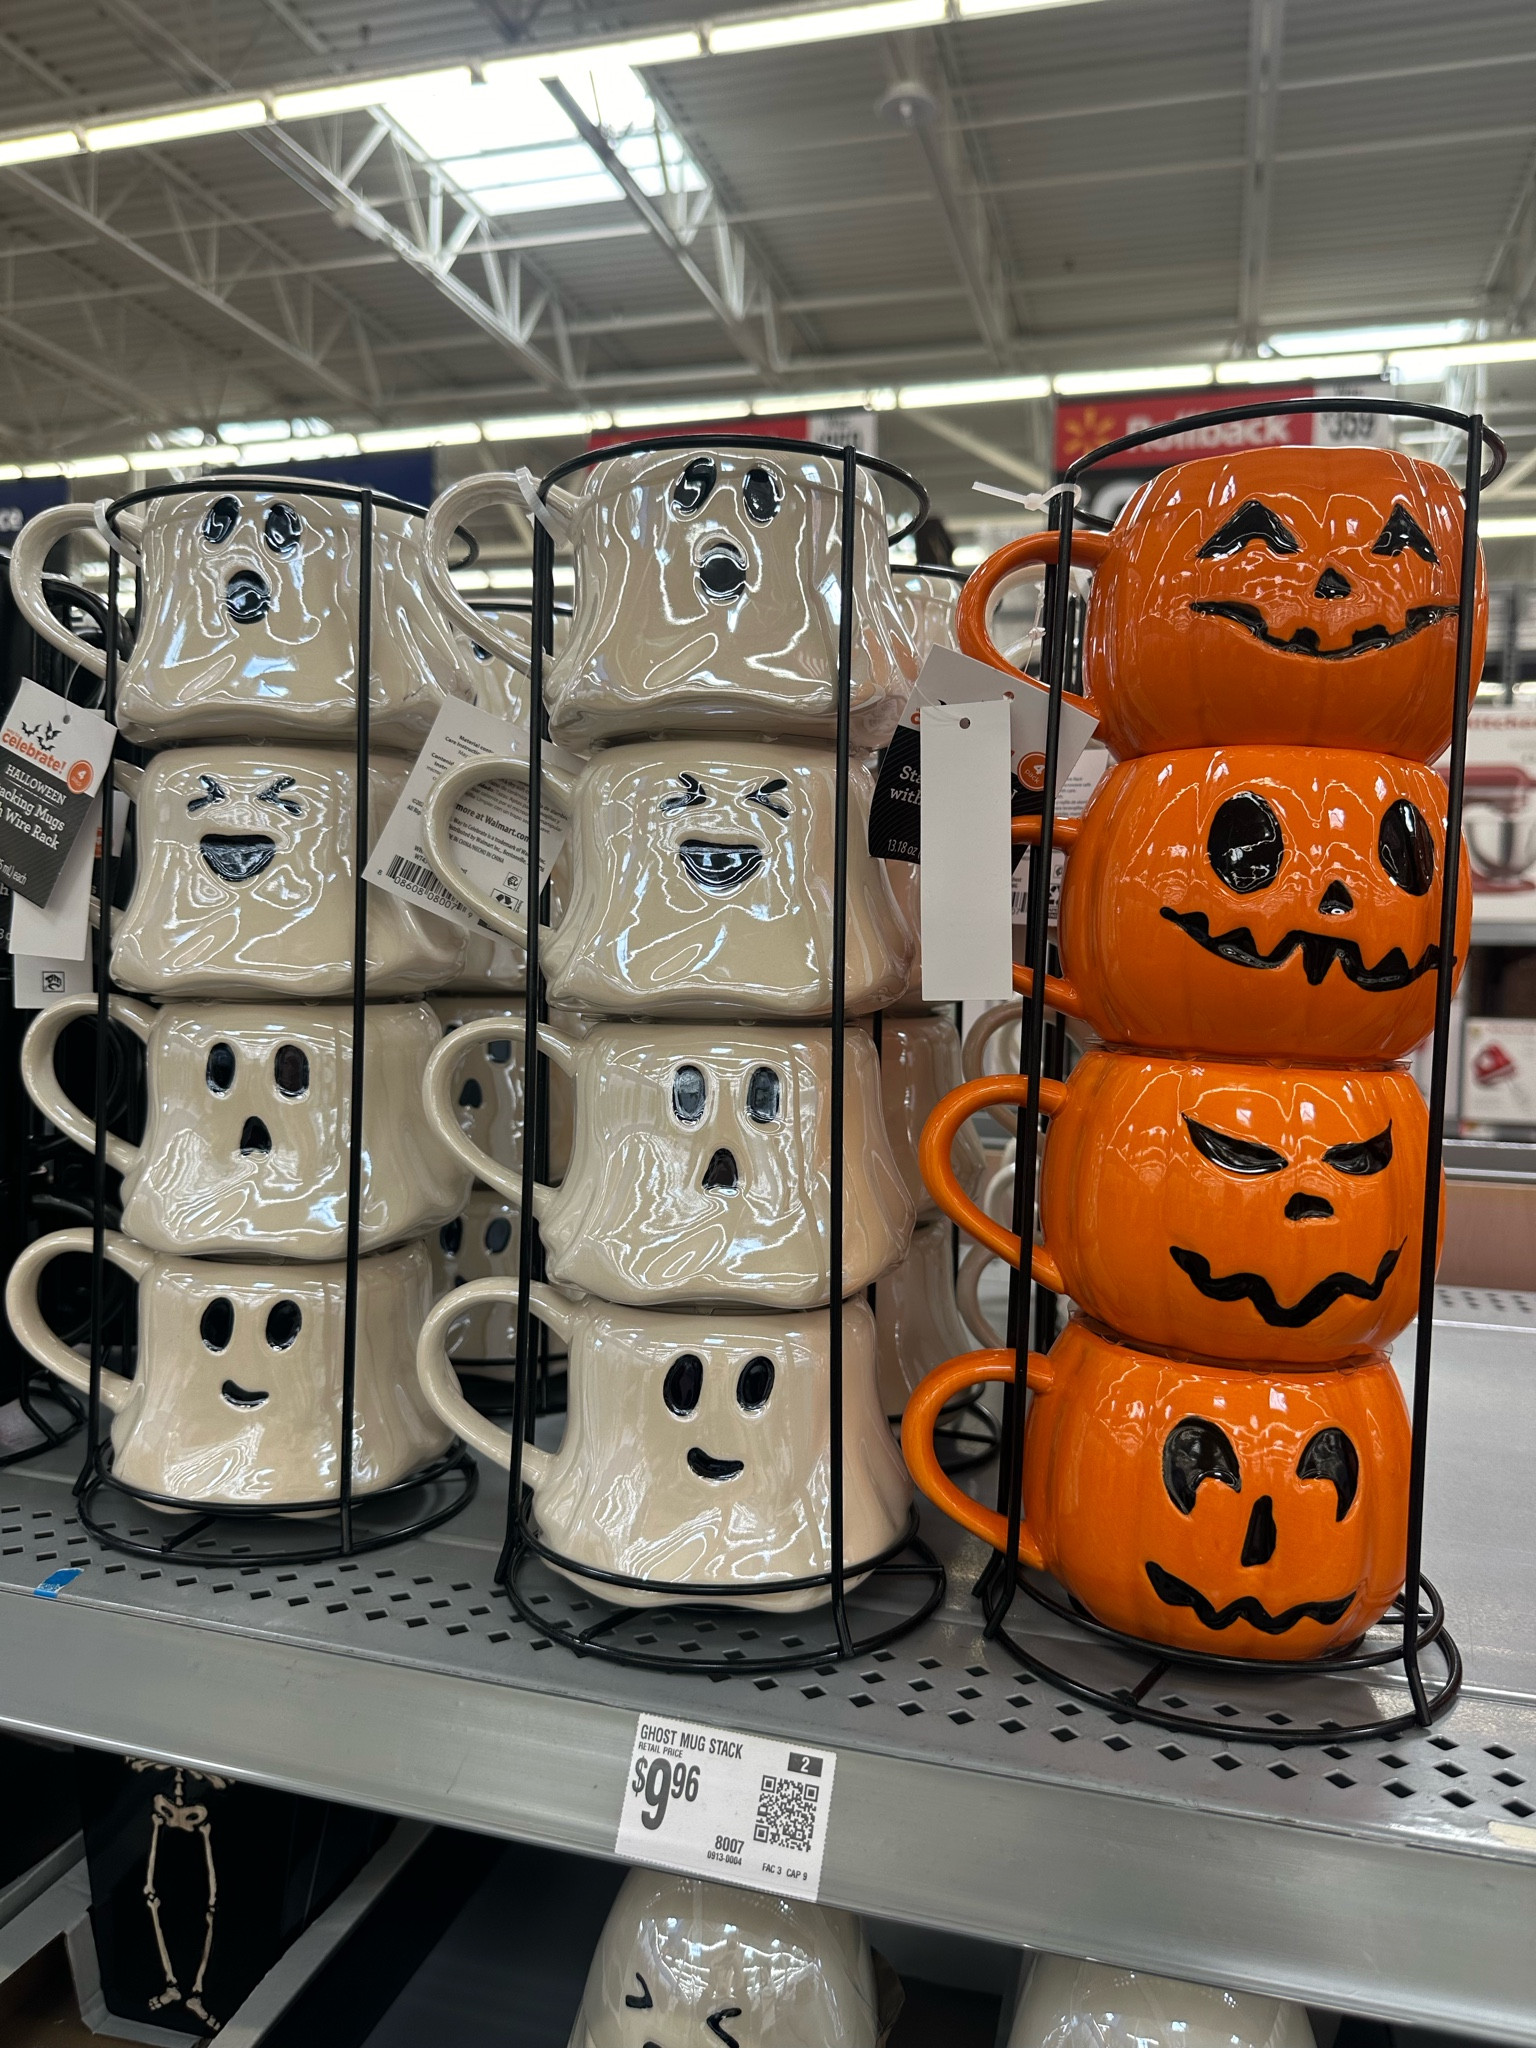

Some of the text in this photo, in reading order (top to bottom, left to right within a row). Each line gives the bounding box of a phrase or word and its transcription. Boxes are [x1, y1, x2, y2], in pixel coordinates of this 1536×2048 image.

[2, 732, 67, 774] celebrate!
[5, 764, 67, 805] HALLOWEEN
[1024, 769, 1041, 784] pack
[0, 786, 65, 831] acking Mugs
[455, 803, 475, 817] more
[475, 812, 485, 821] at
[5, 808, 60, 850] Wire Rack
[908, 845, 919, 856] oz
[393, 875, 425, 896] 08608
[426, 891, 458, 912] 08007
[638, 1741, 683, 1758] RETAIL PRICE
[640, 1724, 743, 1759] GHOST MUG STACK
[800, 1757, 810, 1773] 2
[714, 1835, 744, 1854] 8007
[762, 1863, 808, 1881] FAC 3 CAP 9
